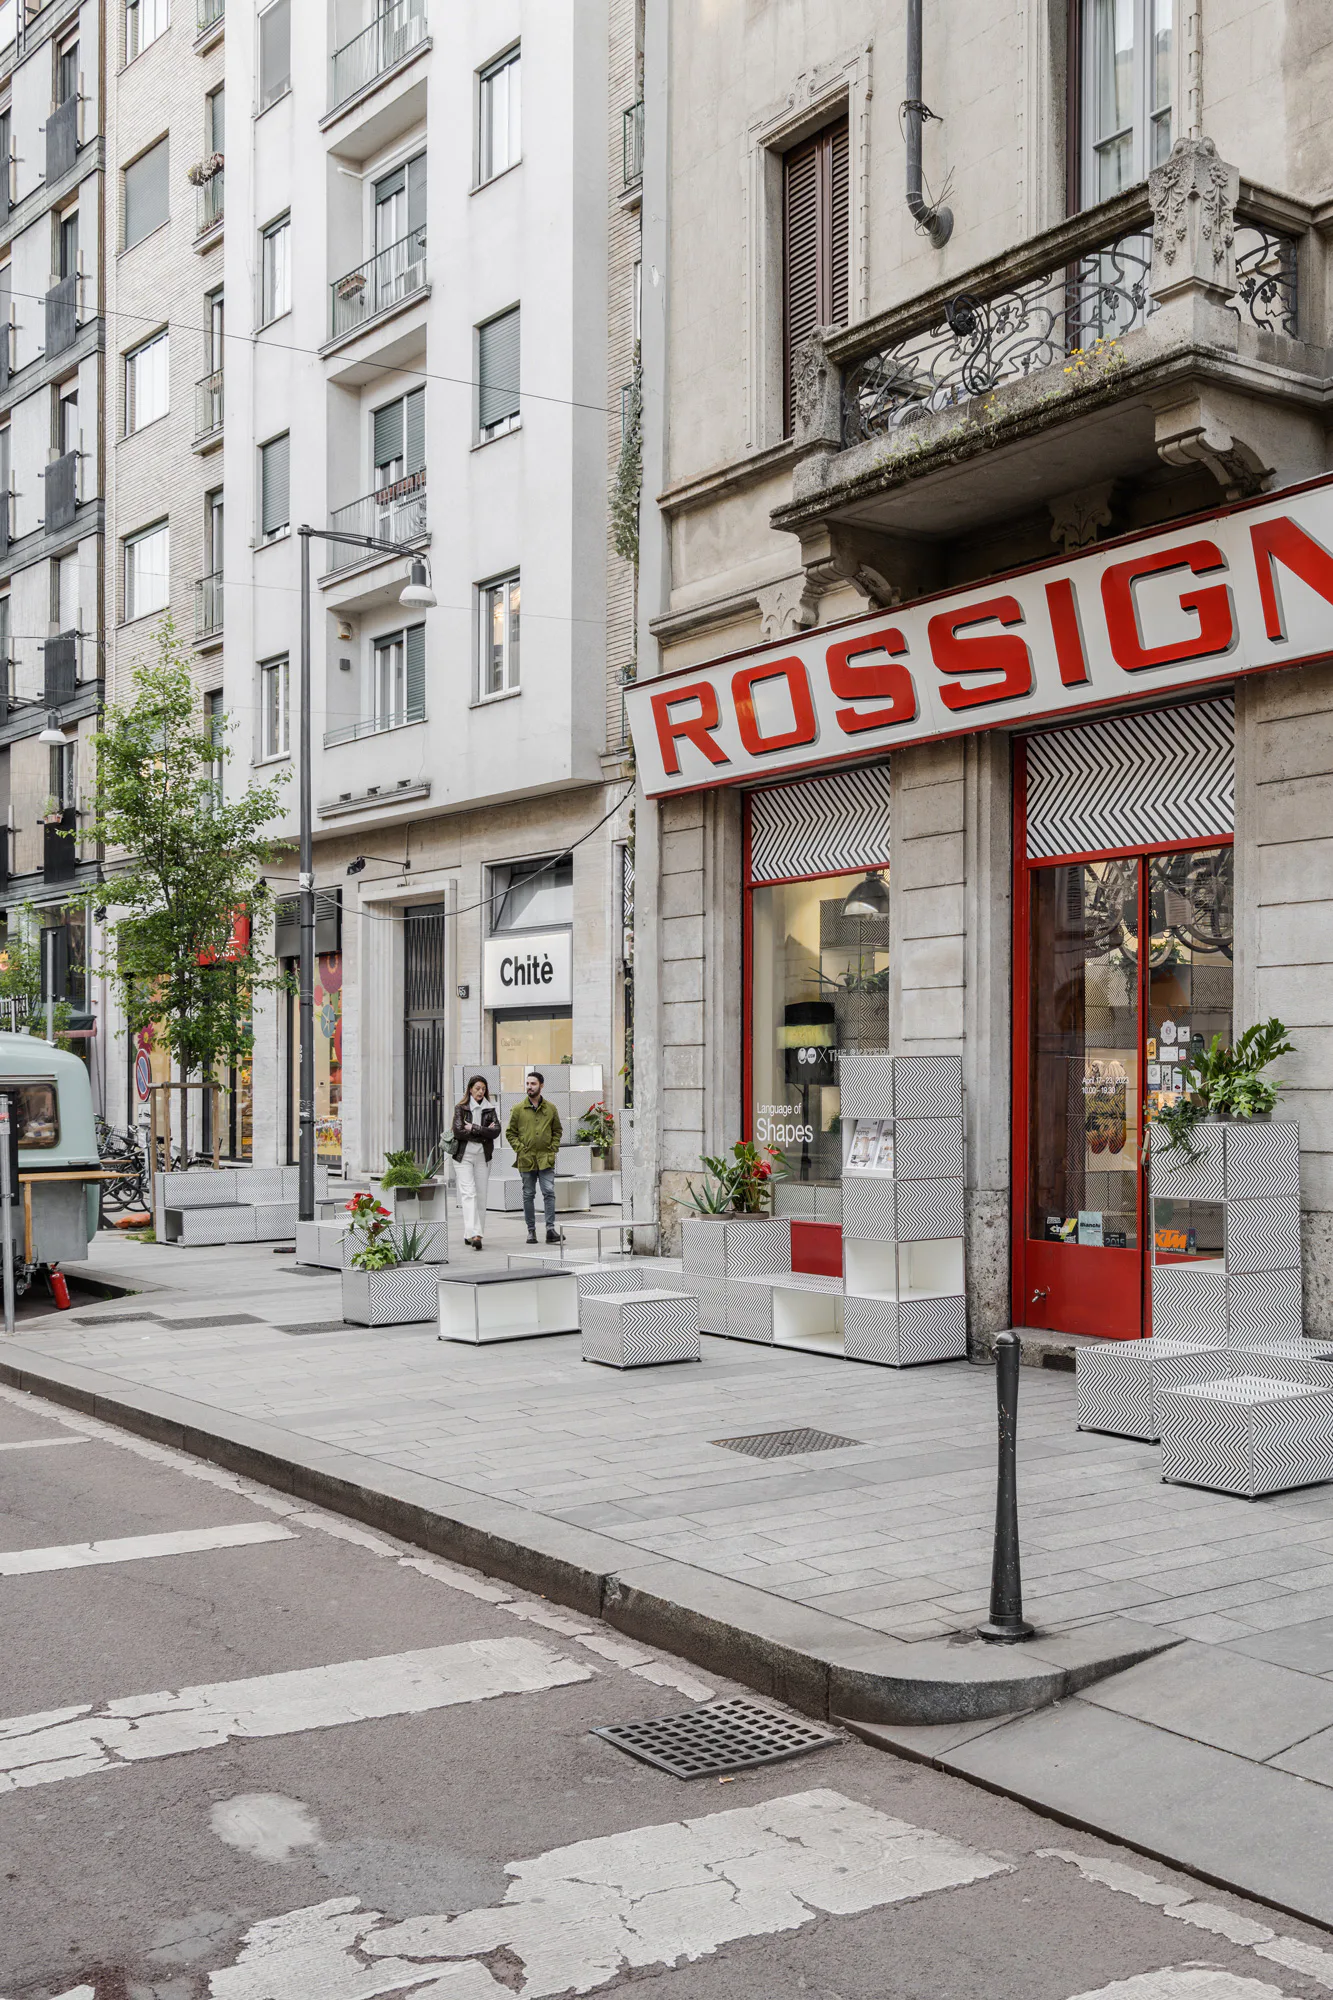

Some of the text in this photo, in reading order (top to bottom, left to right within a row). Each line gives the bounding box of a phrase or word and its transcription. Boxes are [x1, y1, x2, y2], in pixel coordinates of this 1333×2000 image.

[500, 953, 553, 987] Chitè
[756, 1102, 802, 1117] Language of
[756, 1117, 814, 1148] Shapes
